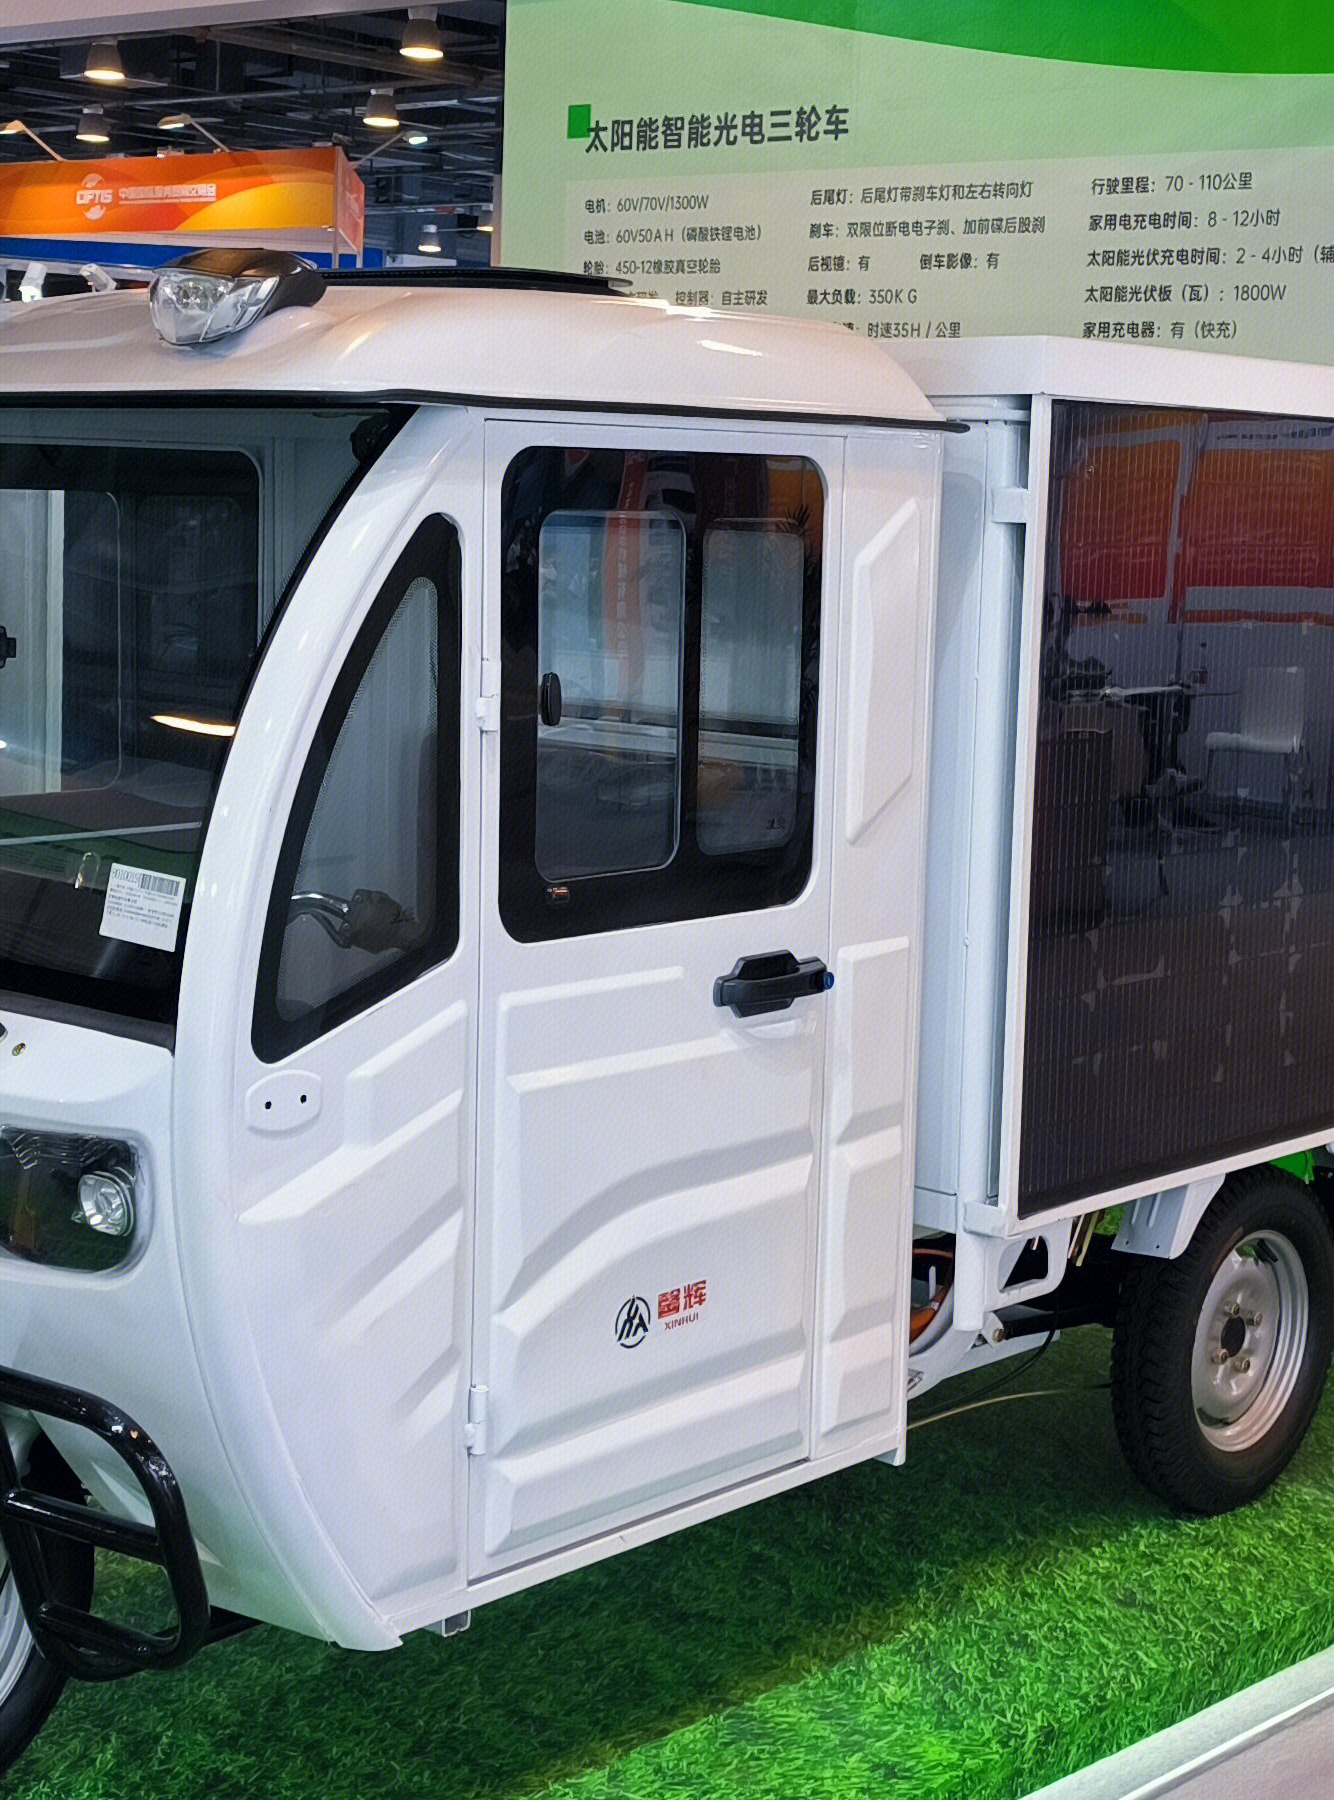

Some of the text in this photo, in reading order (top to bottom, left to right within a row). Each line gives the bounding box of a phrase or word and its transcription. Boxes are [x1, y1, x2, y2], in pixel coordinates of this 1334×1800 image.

[585, 103, 850, 154] 太阳能智能光电三轮车
[664, 1312, 700, 1331] XINHUI
